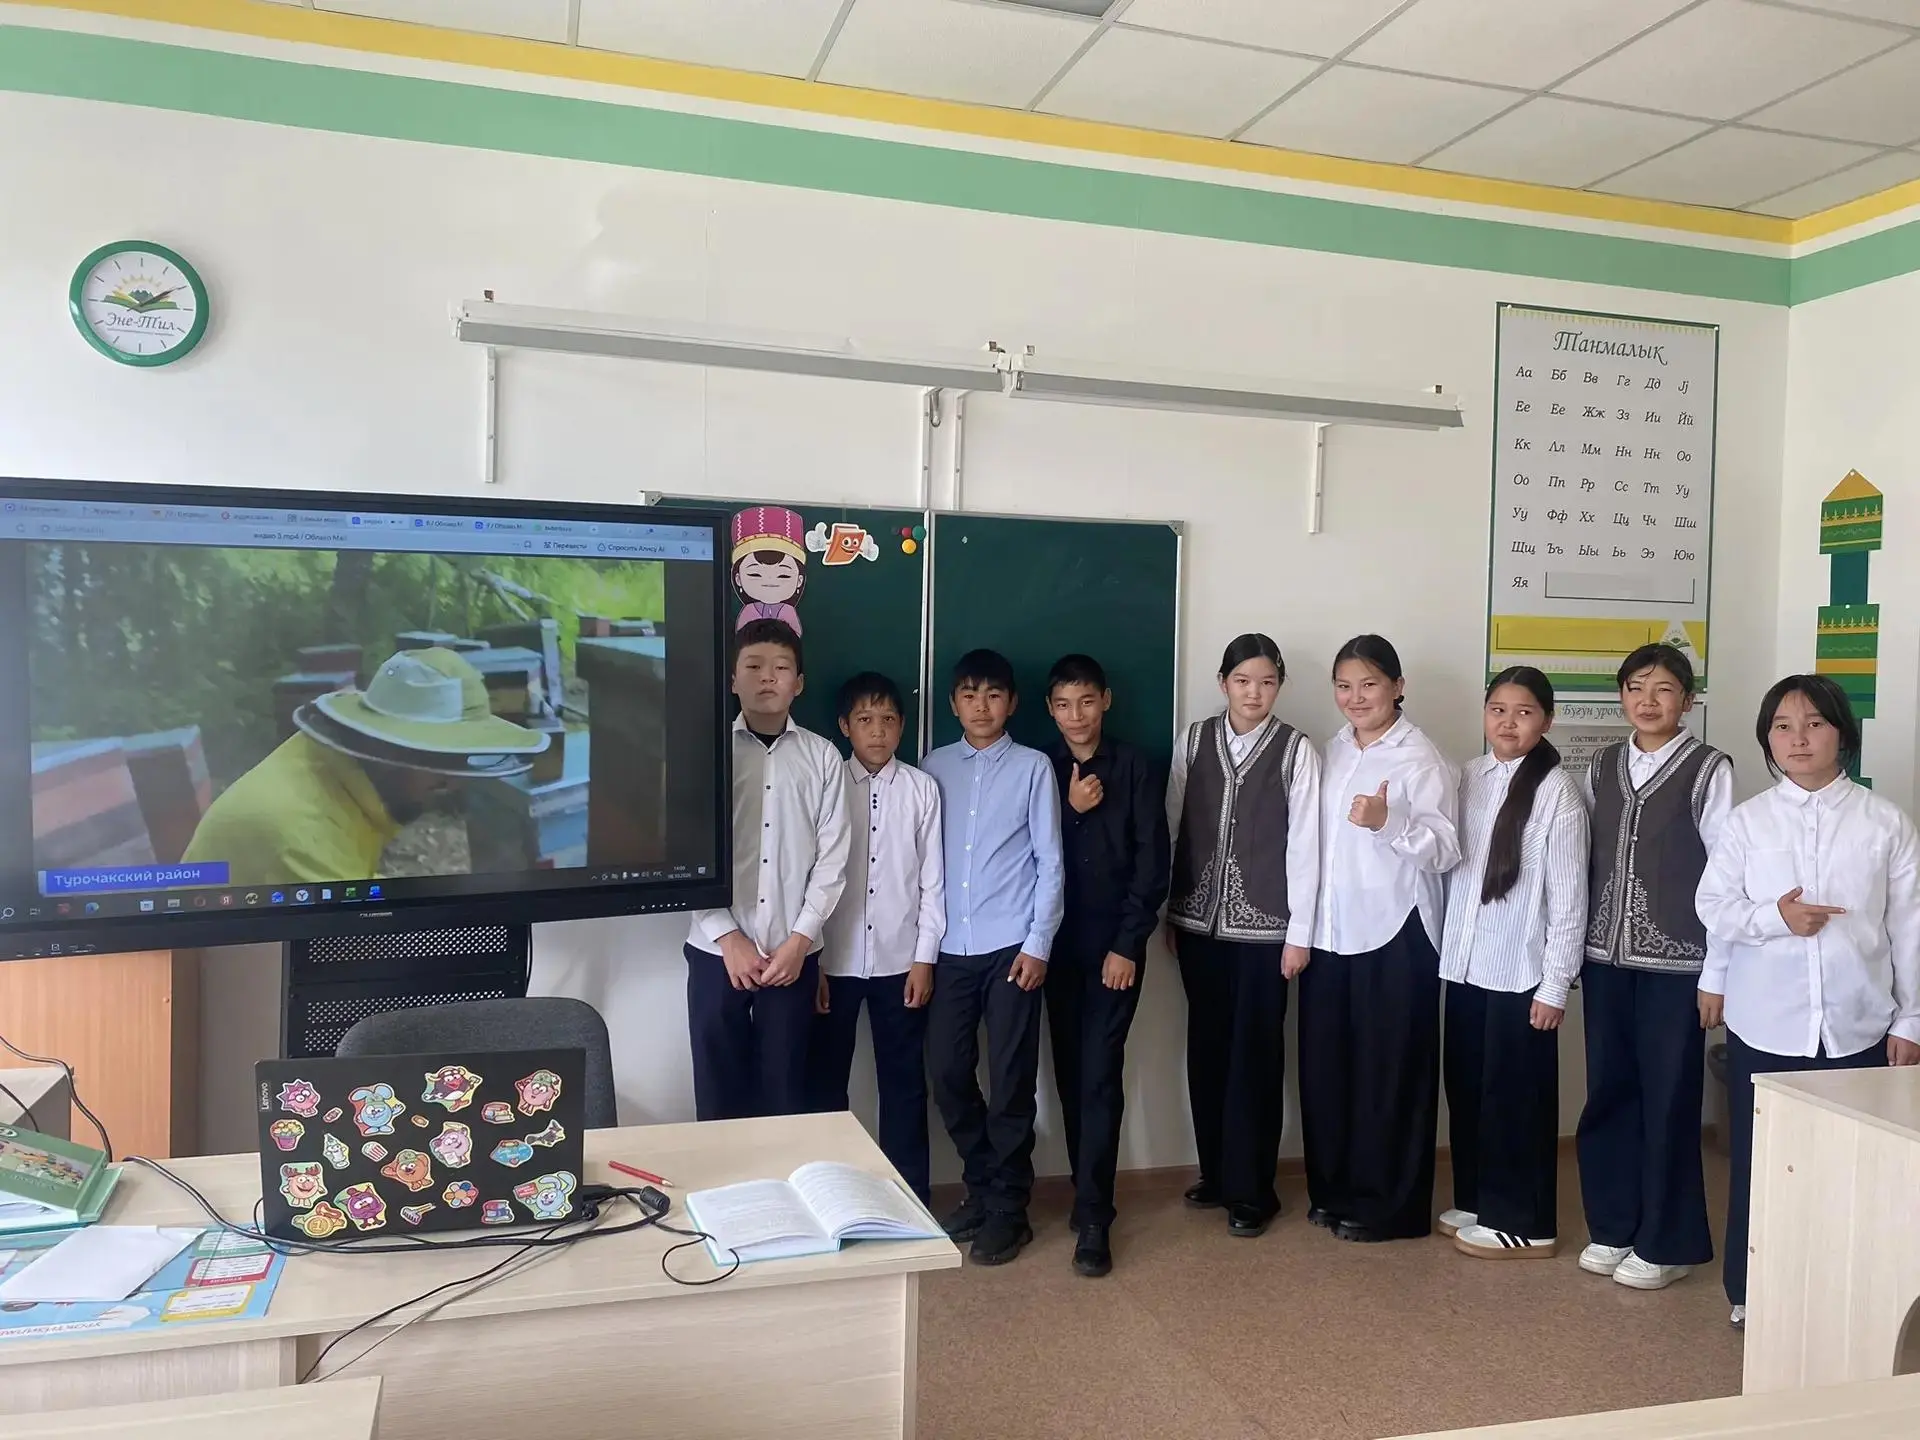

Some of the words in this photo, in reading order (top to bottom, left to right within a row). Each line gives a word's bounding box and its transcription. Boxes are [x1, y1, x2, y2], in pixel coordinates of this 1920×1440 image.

[106, 312, 175, 330] Эне-Тил
[1553, 331, 1667, 365] Танмалык
[1516, 366, 1533, 377] Аа
[1551, 369, 1568, 380] Бб
[1584, 372, 1599, 383] Вв
[1617, 375, 1631, 386] Гг
[1644, 378, 1661, 390] Дд
[1516, 401, 1531, 412] Ее
[1582, 406, 1606, 418] Жж
[1616, 409, 1630, 420] Зз
[1645, 412, 1661, 423] Ии
[1678, 412, 1694, 425] Йй
[1515, 439, 1531, 450] Кк
[1549, 441, 1565, 452] Лл
[1582, 443, 1602, 455] Мм
[1615, 446, 1632, 457] Нн
[1677, 451, 1692, 462] Оо
[1548, 476, 1566, 487] Пп
[1580, 478, 1596, 492] Рр
[1615, 481, 1629, 492] Сс
[1644, 482, 1660, 493] Тт
[1547, 510, 1568, 523] Фф
[1579, 511, 1596, 522] Хх
[1613, 513, 1630, 526] Цц
[1643, 515, 1657, 526] Чч
[1675, 517, 1697, 528] Шш
[1512, 541, 1536, 555] Щщ
[1547, 543, 1564, 554] Ъъ
[1579, 545, 1599, 556] Ыы
[1612, 547, 1627, 557] Ьь
[1641, 548, 1655, 559] Ээ
[1674, 550, 1695, 560] Юю
[1512, 577, 1529, 587] Яя
[54, 870, 152, 887] Турочакский
[156, 869, 201, 882] район
[261, 1082, 270, 1110] Lenovo
